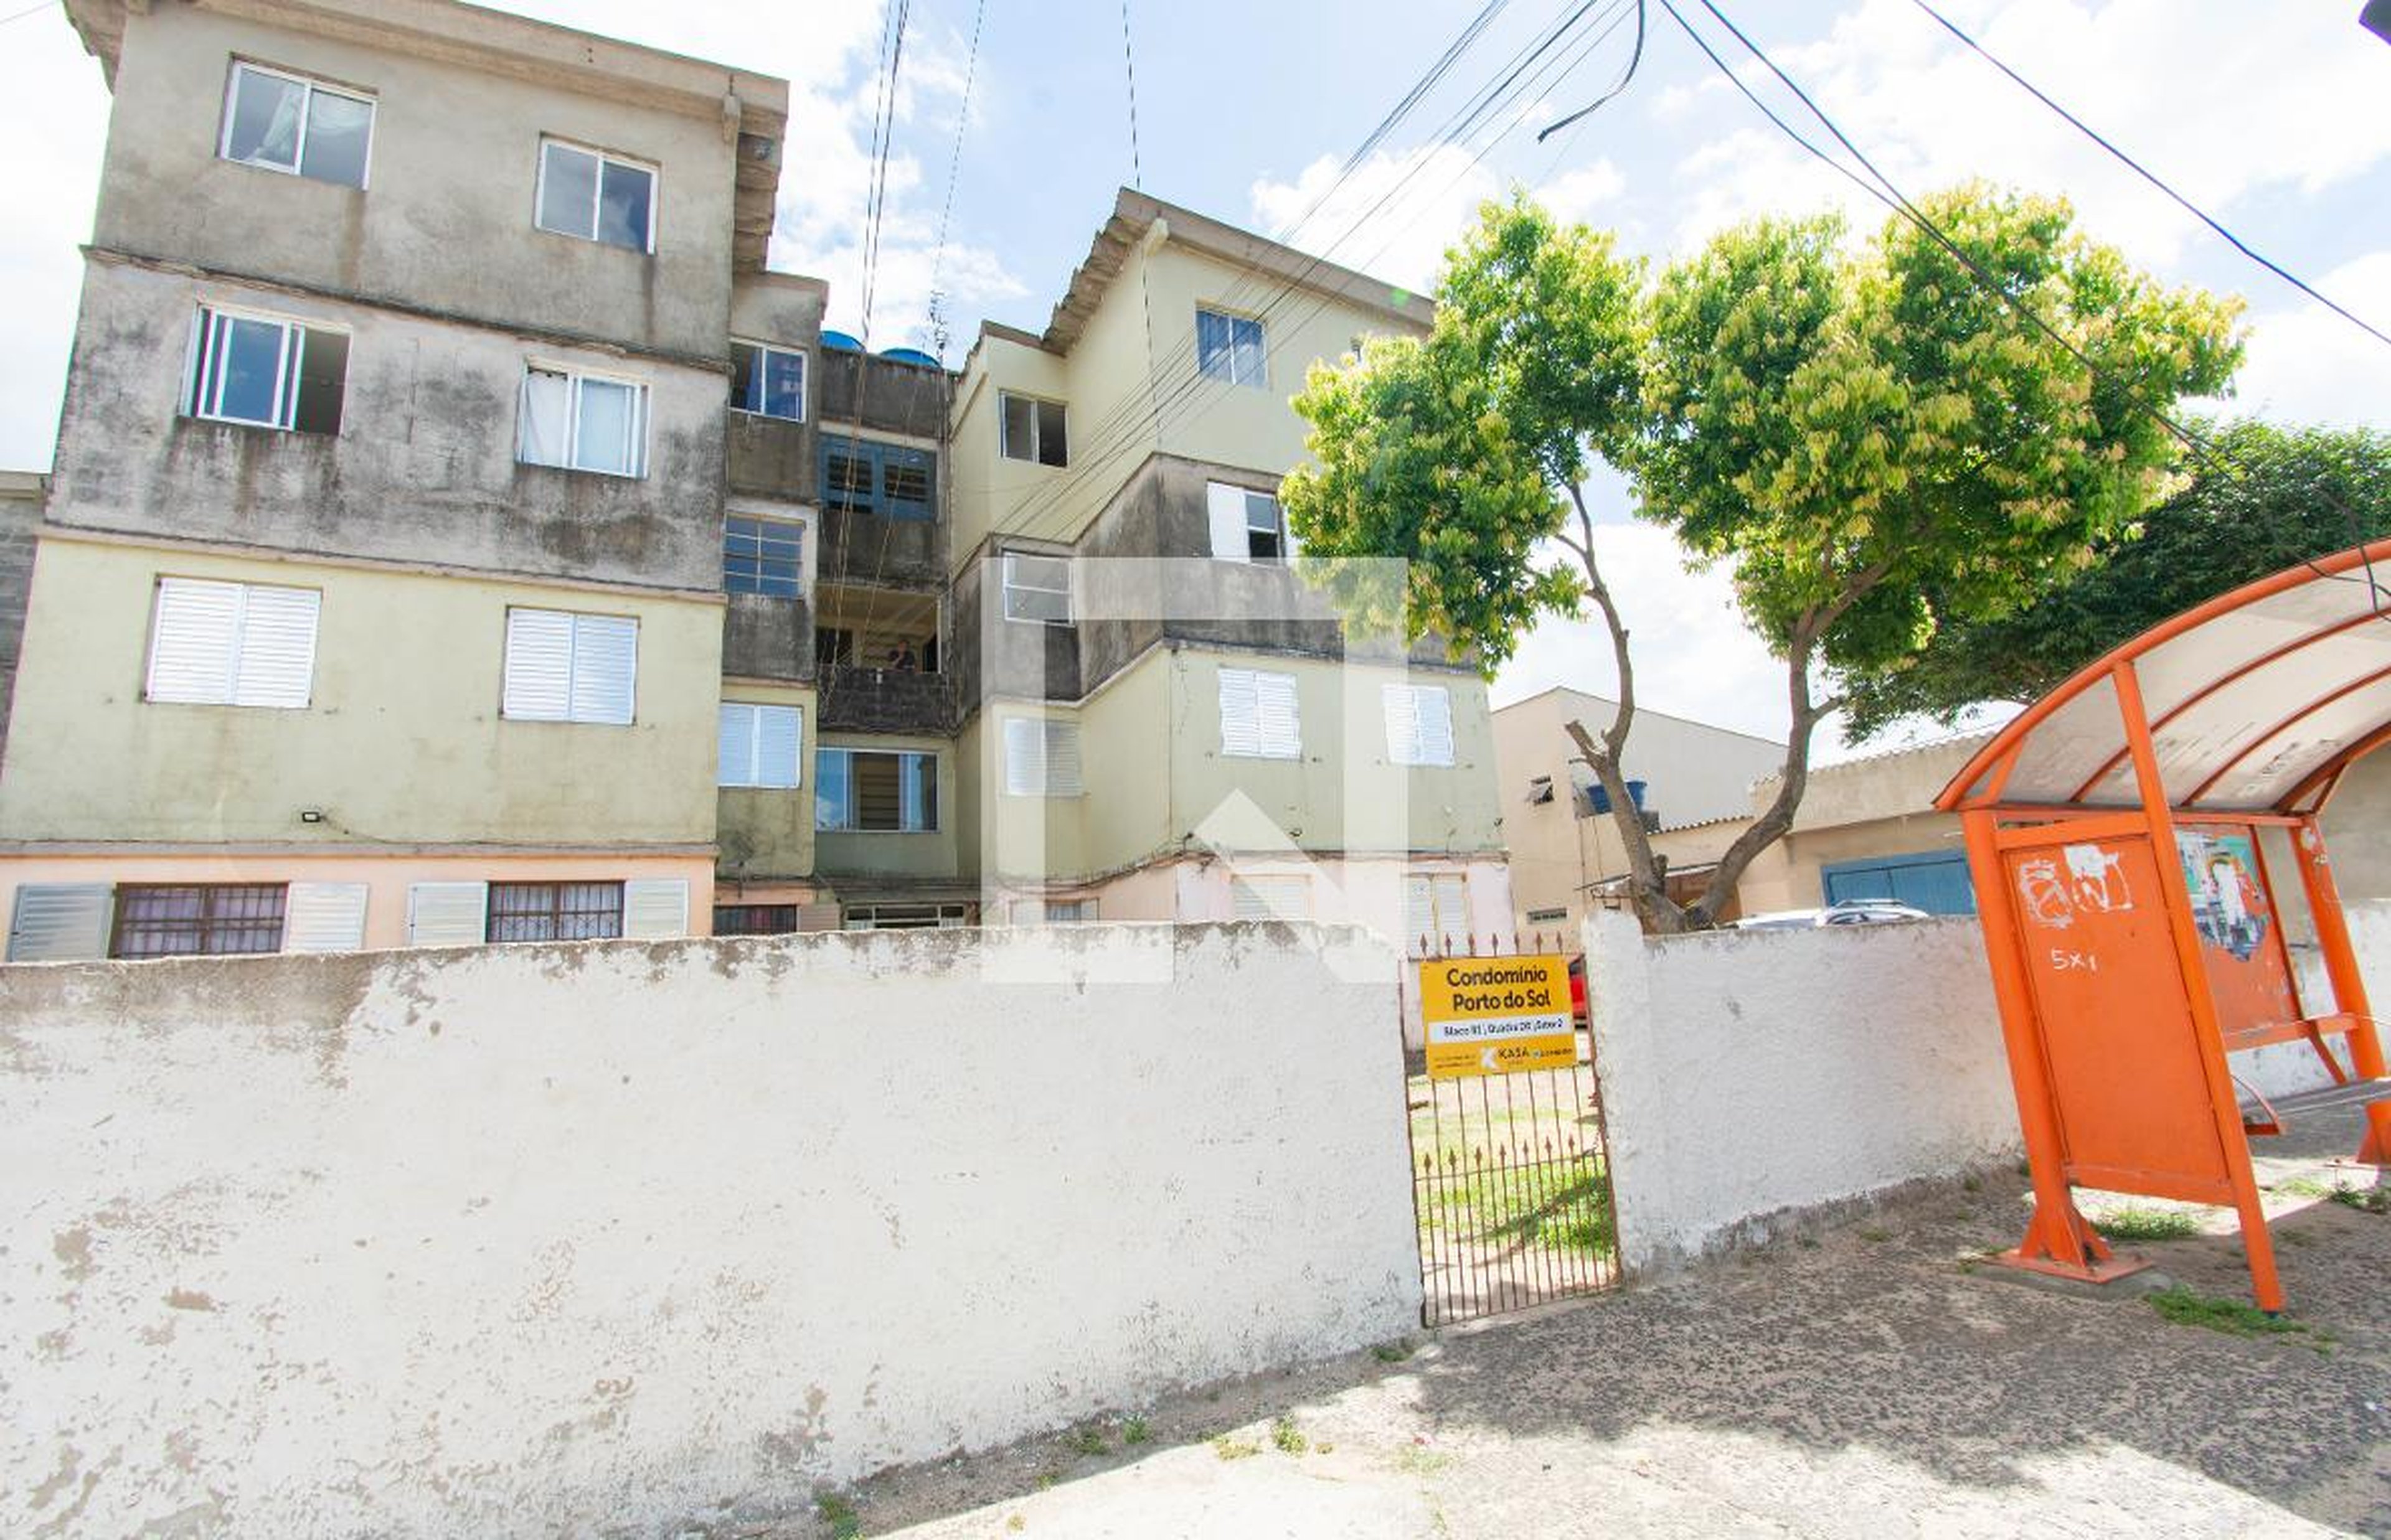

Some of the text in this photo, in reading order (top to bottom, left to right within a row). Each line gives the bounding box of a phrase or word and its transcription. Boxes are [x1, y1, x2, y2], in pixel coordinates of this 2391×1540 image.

[1453, 988, 1550, 1011] Porto do Sol
